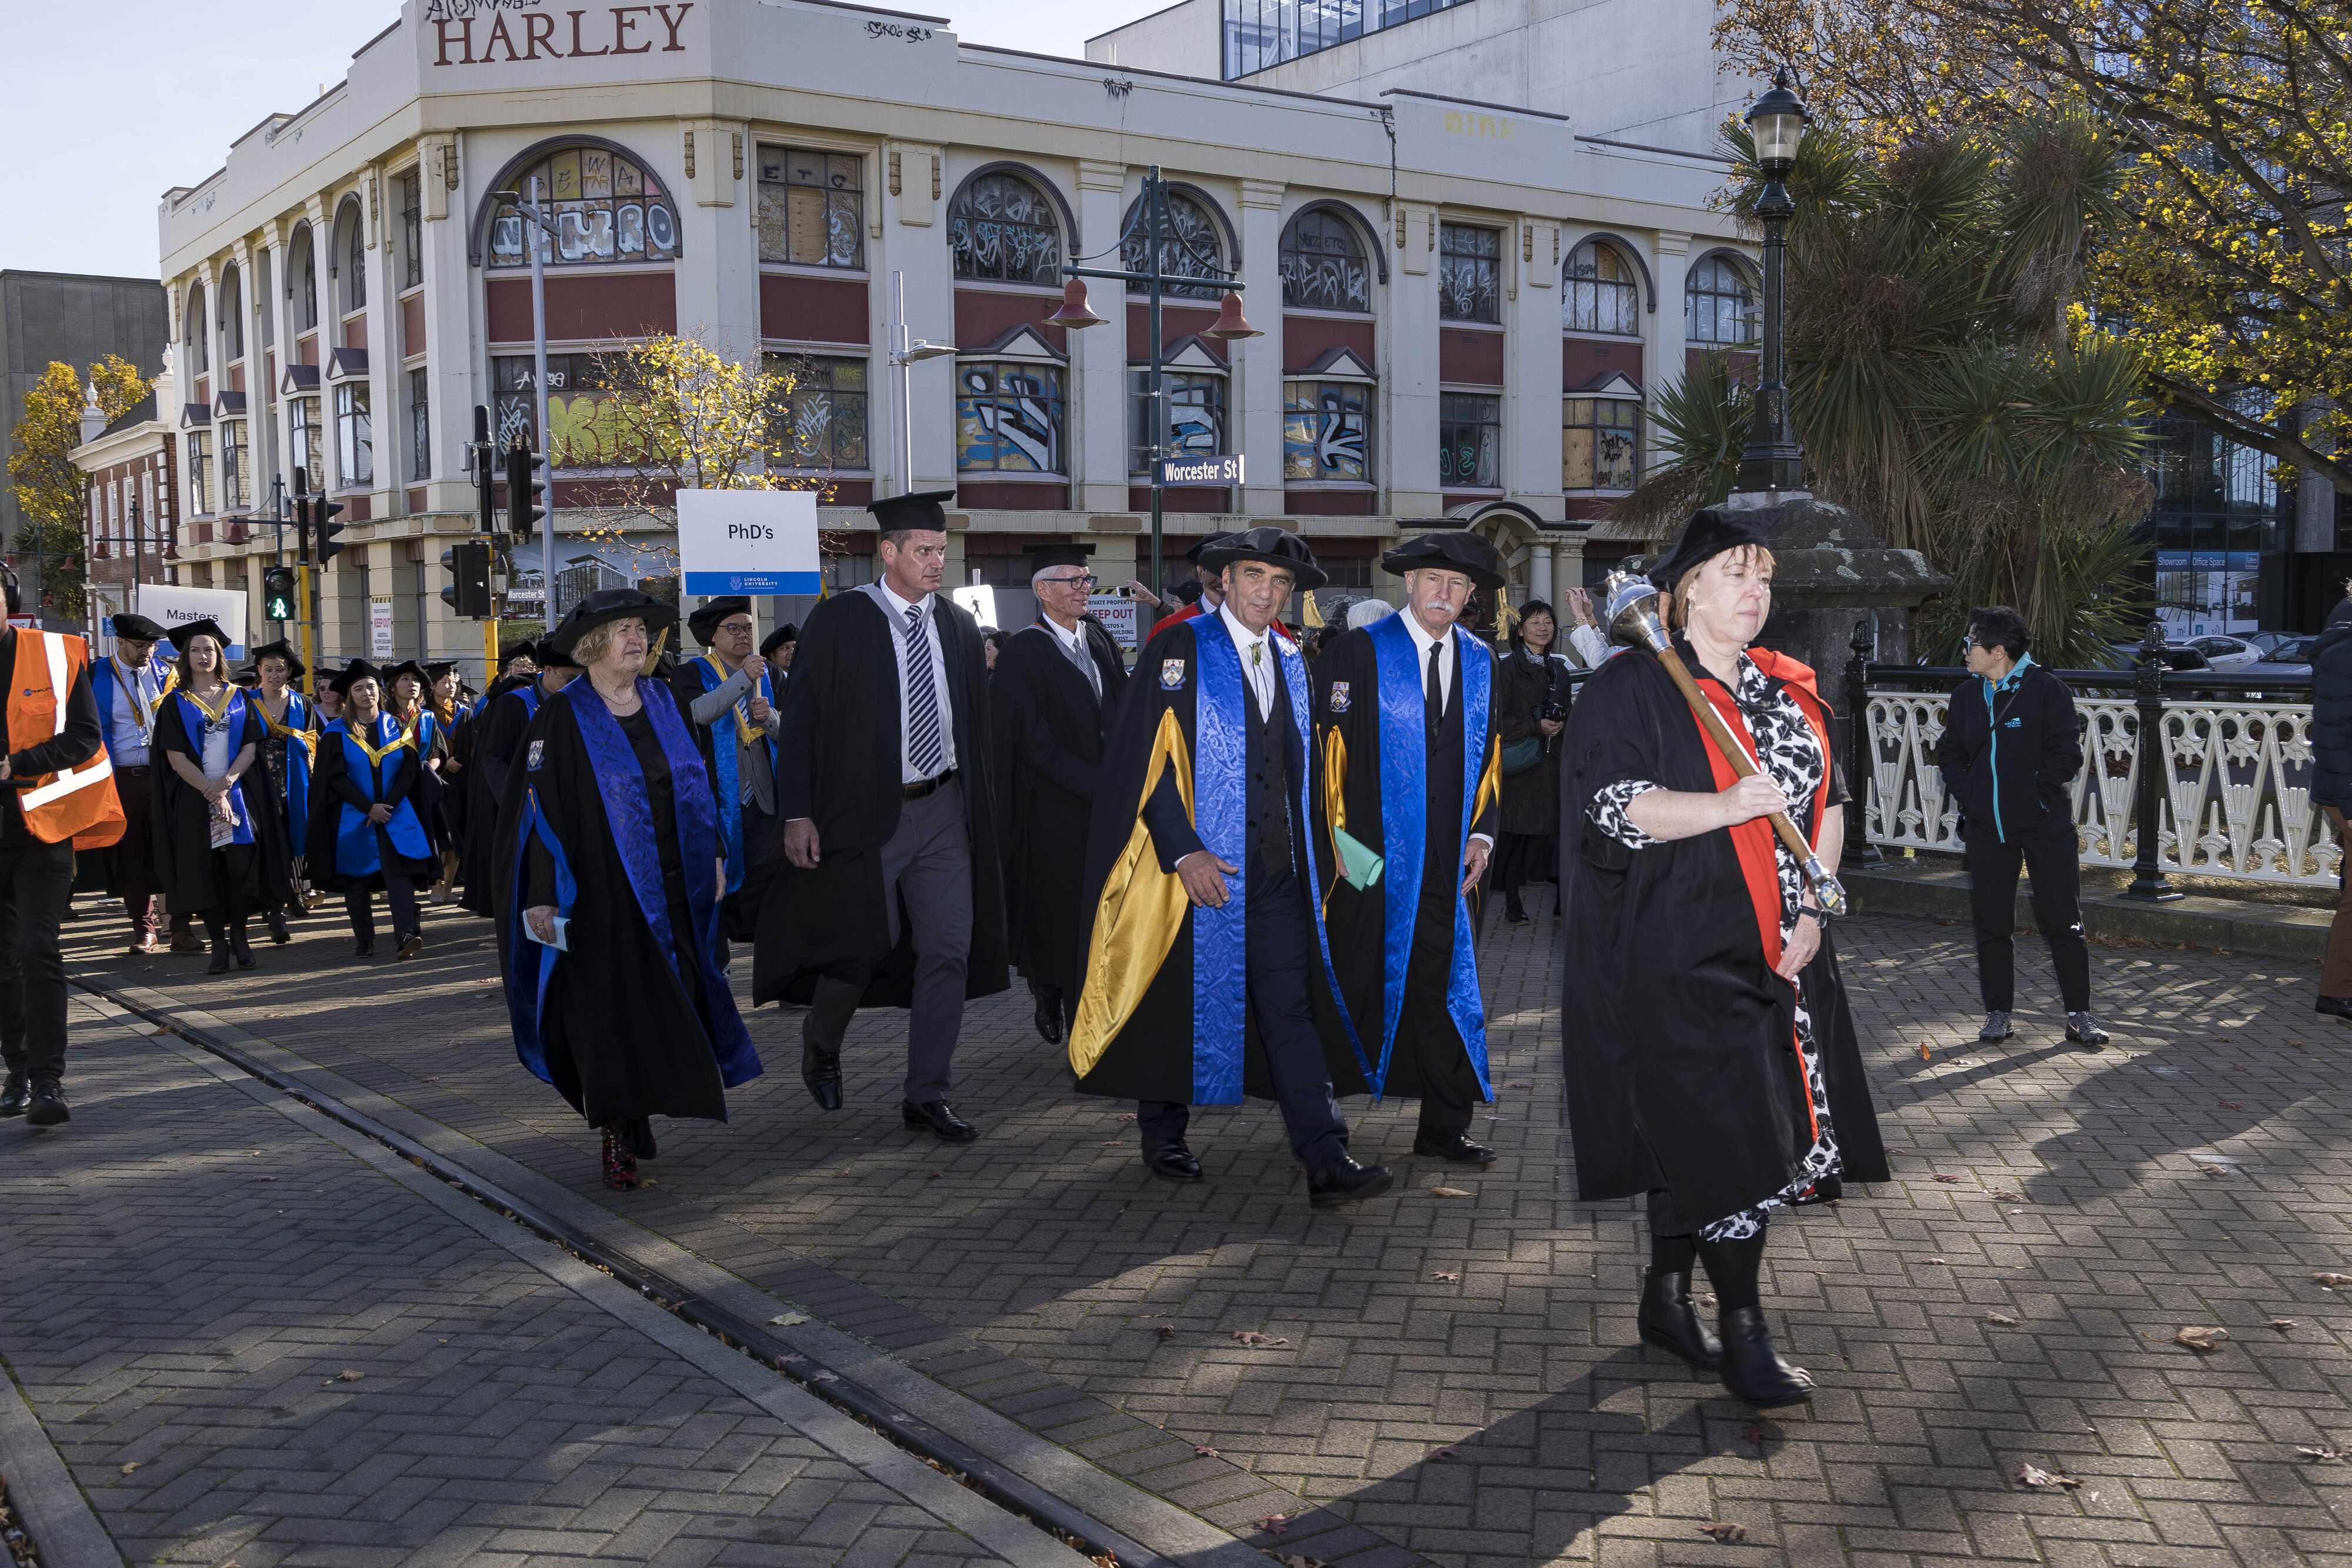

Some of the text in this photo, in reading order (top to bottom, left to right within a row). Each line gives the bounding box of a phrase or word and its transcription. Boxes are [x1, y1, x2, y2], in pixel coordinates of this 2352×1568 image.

[432, 2, 693, 66] HARLEY
[1165, 459, 1237, 481] Worcester St
[728, 523, 774, 539] PhD's
[2158, 557, 2226, 568] Showroom Office Space
[538, 589, 545, 599] St
[166, 609, 219, 622] Masters
[1113, 608, 1133, 619] OUT
